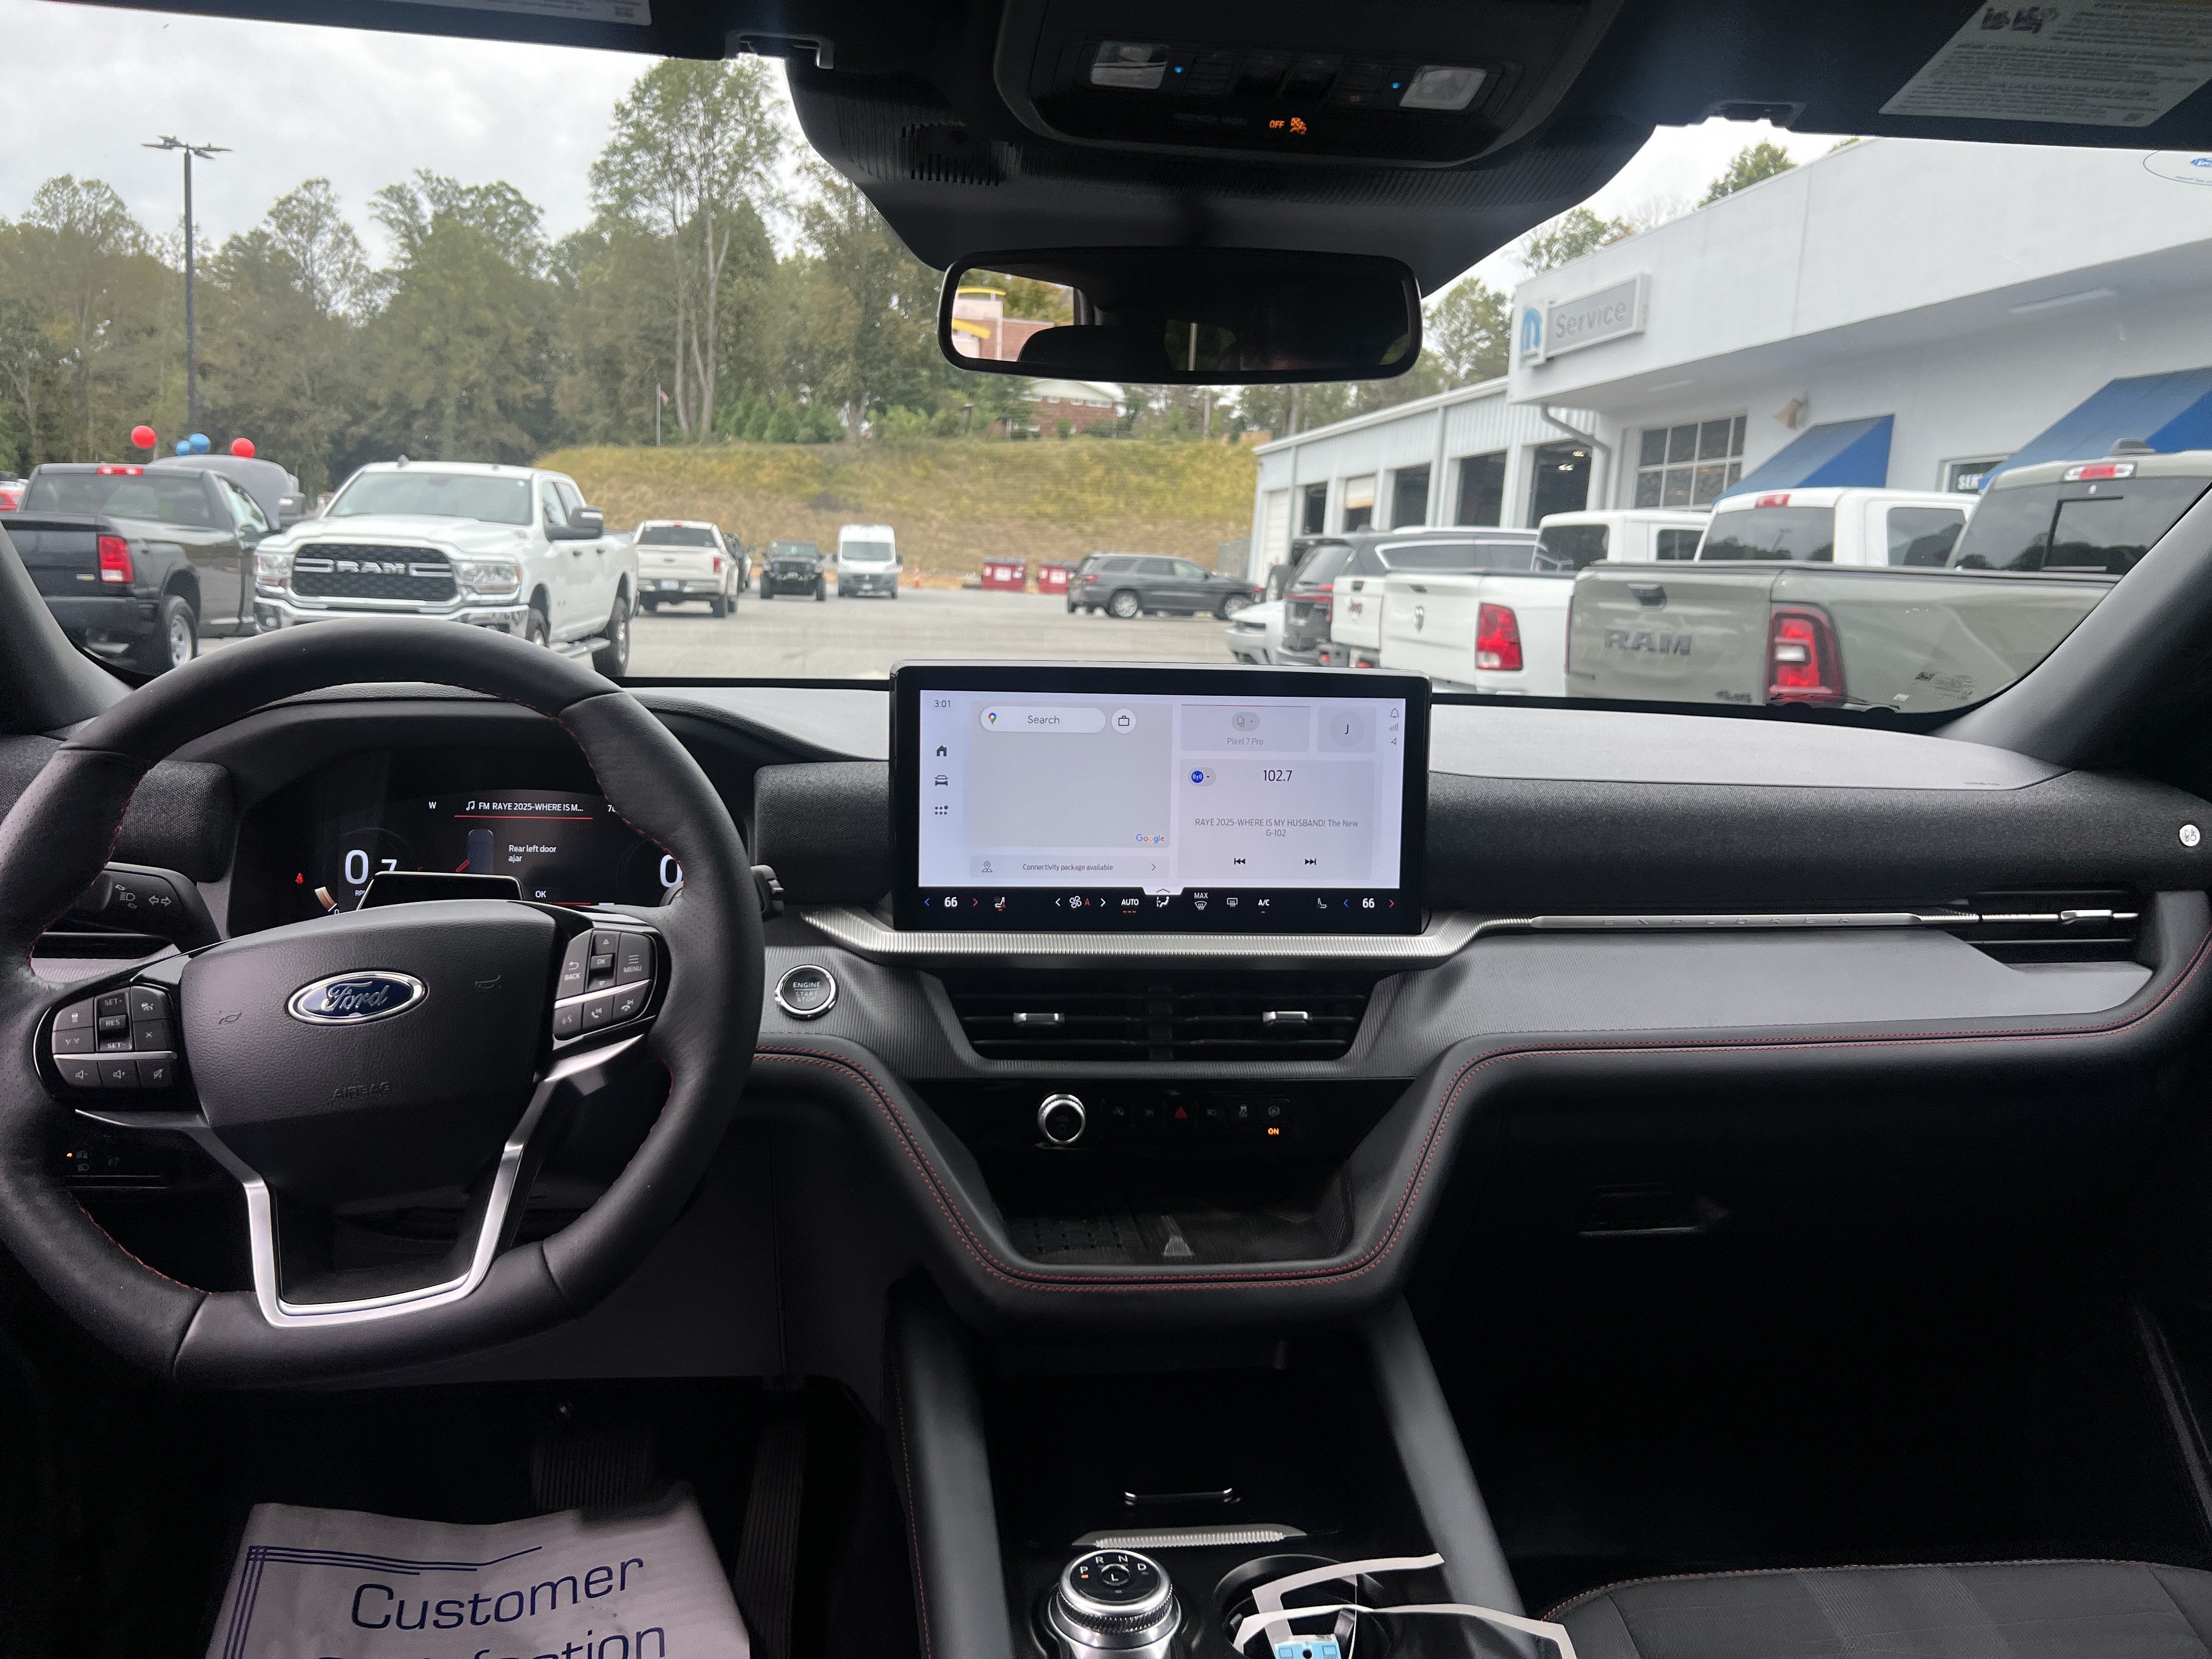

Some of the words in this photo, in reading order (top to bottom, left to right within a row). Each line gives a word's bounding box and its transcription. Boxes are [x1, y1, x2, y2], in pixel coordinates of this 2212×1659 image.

[1269, 120, 1285, 129] OFF
[1555, 301, 1627, 339] Service
[337, 560, 406, 574] RAM
[1604, 629, 1692, 656] RAM
[934, 699, 951, 708] 3:01
[1028, 715, 1060, 724] Search
[1345, 724, 1349, 735] J
[1263, 770, 1293, 782] 102.7
[514, 803, 562, 811] 2025-WHERE
[1136, 833, 1165, 844] Google
[345, 849, 369, 884] 0
[944, 896, 958, 907] 66
[1362, 898, 1375, 909] 66
[321, 981, 390, 1012] Ford
[105, 1019, 120, 1027] RES
[334, 1081, 392, 1098] AIRBAG
[1111, 1573, 1119, 1582] L
[351, 1557, 644, 1630] Customer
